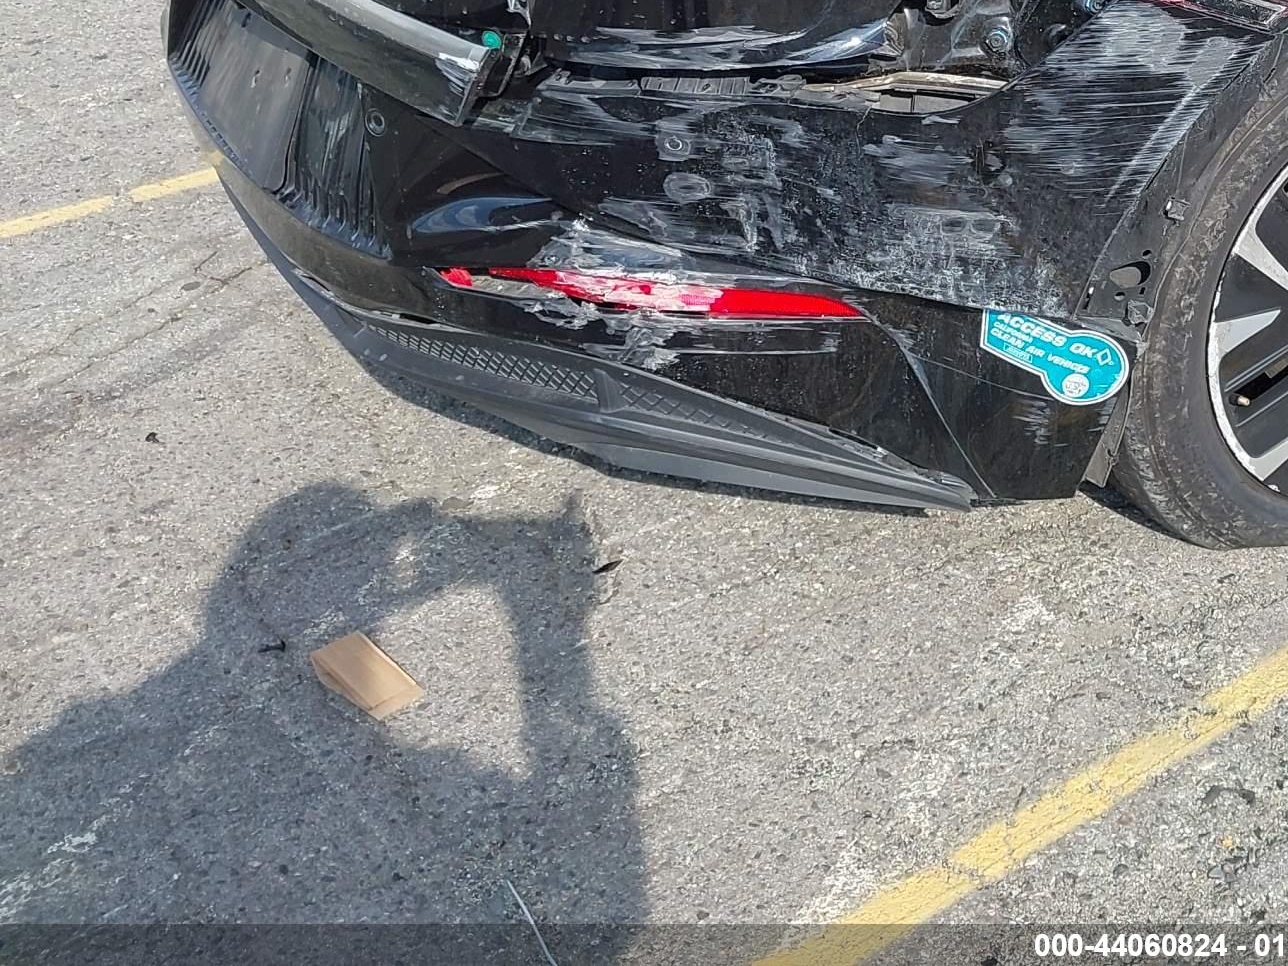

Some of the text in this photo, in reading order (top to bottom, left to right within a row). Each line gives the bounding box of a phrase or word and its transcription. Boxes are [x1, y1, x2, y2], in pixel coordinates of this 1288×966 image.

[990, 327, 1025, 348] CLEAN
[1025, 345, 1046, 358] AIR
[1046, 353, 1091, 375] VEHICLE
[997, 313, 1098, 358] ACCESS OK
